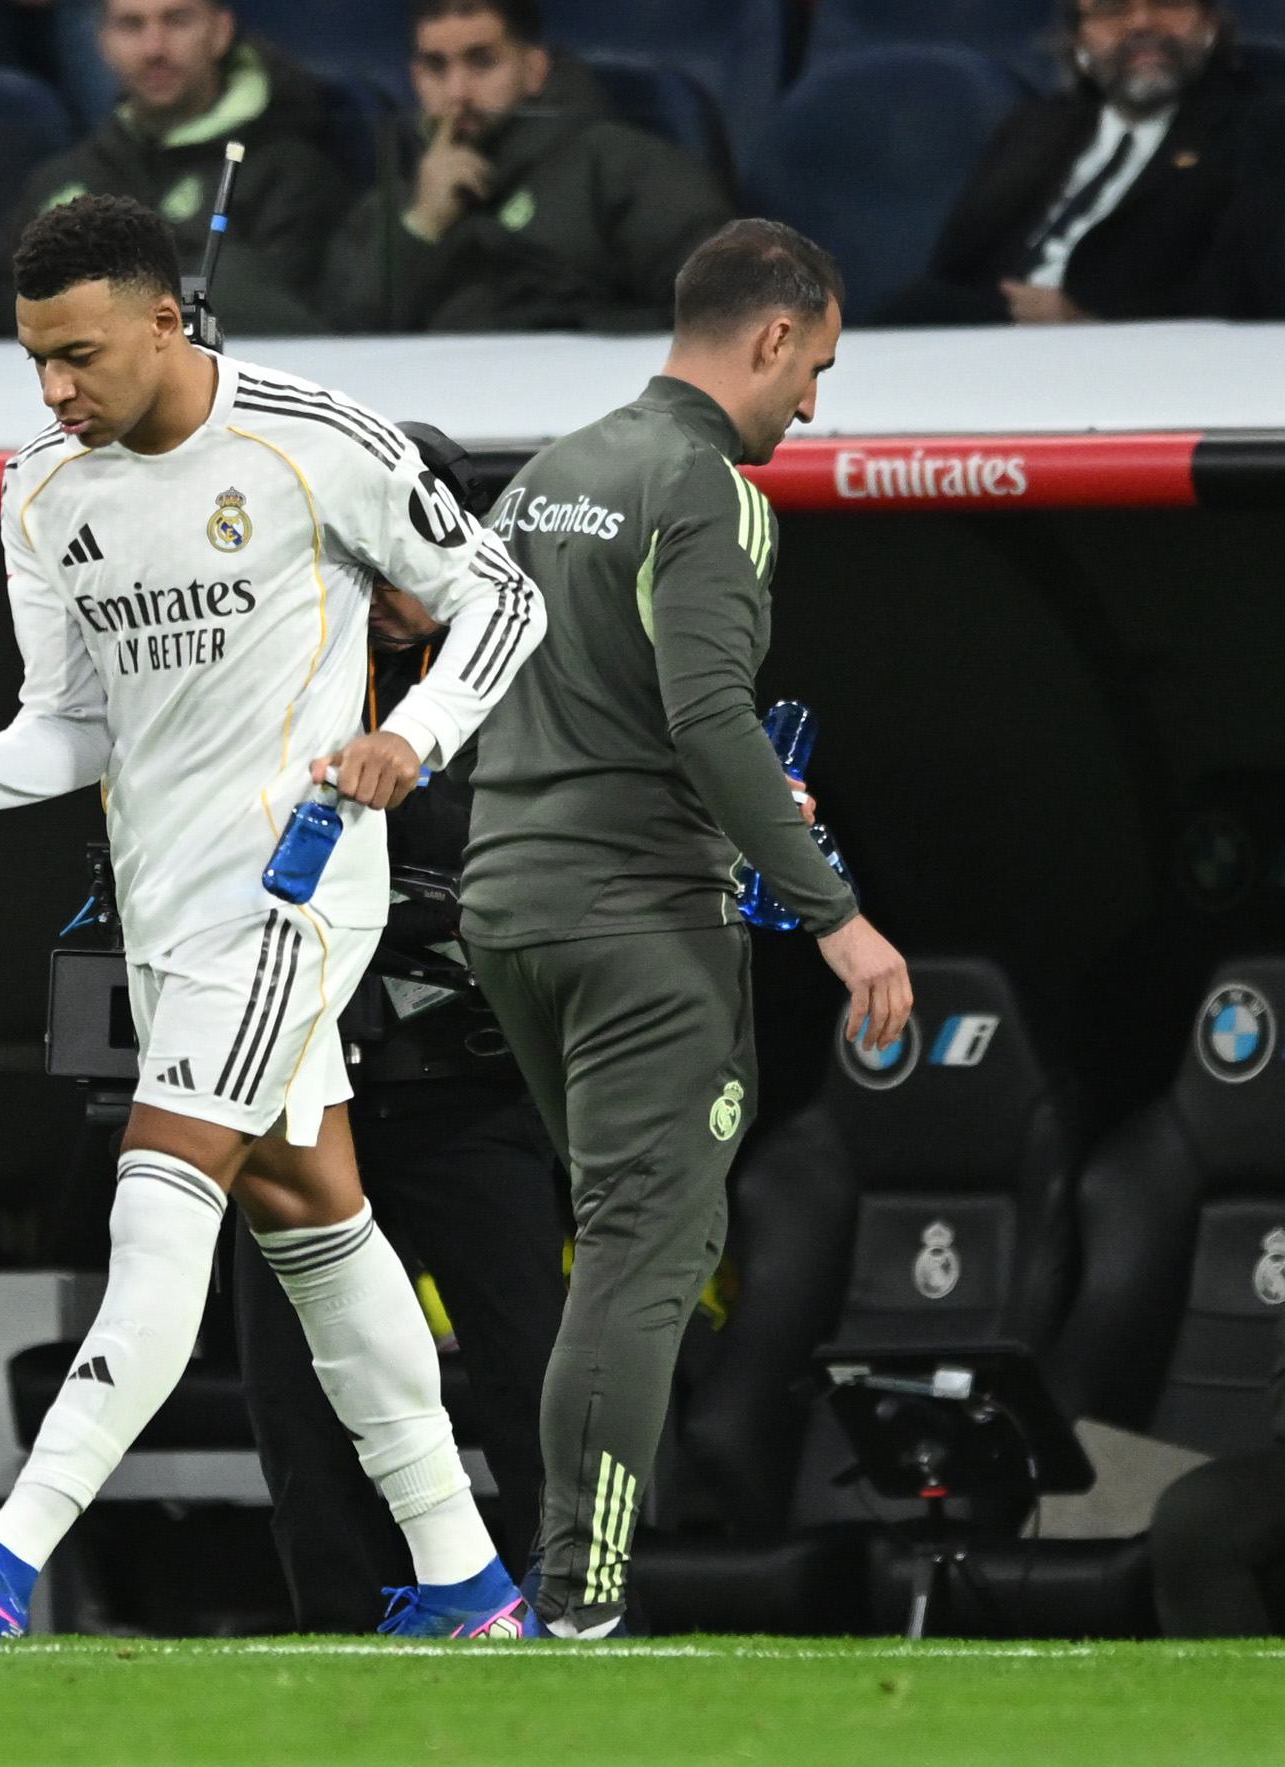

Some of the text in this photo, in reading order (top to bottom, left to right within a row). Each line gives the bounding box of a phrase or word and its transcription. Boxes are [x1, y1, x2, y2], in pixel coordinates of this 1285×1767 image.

[836, 450, 1027, 498] Emirates
[517, 495, 625, 540] Sanitas
[75, 578, 256, 633] Emirates
[116, 627, 226, 675] LY BETTER
